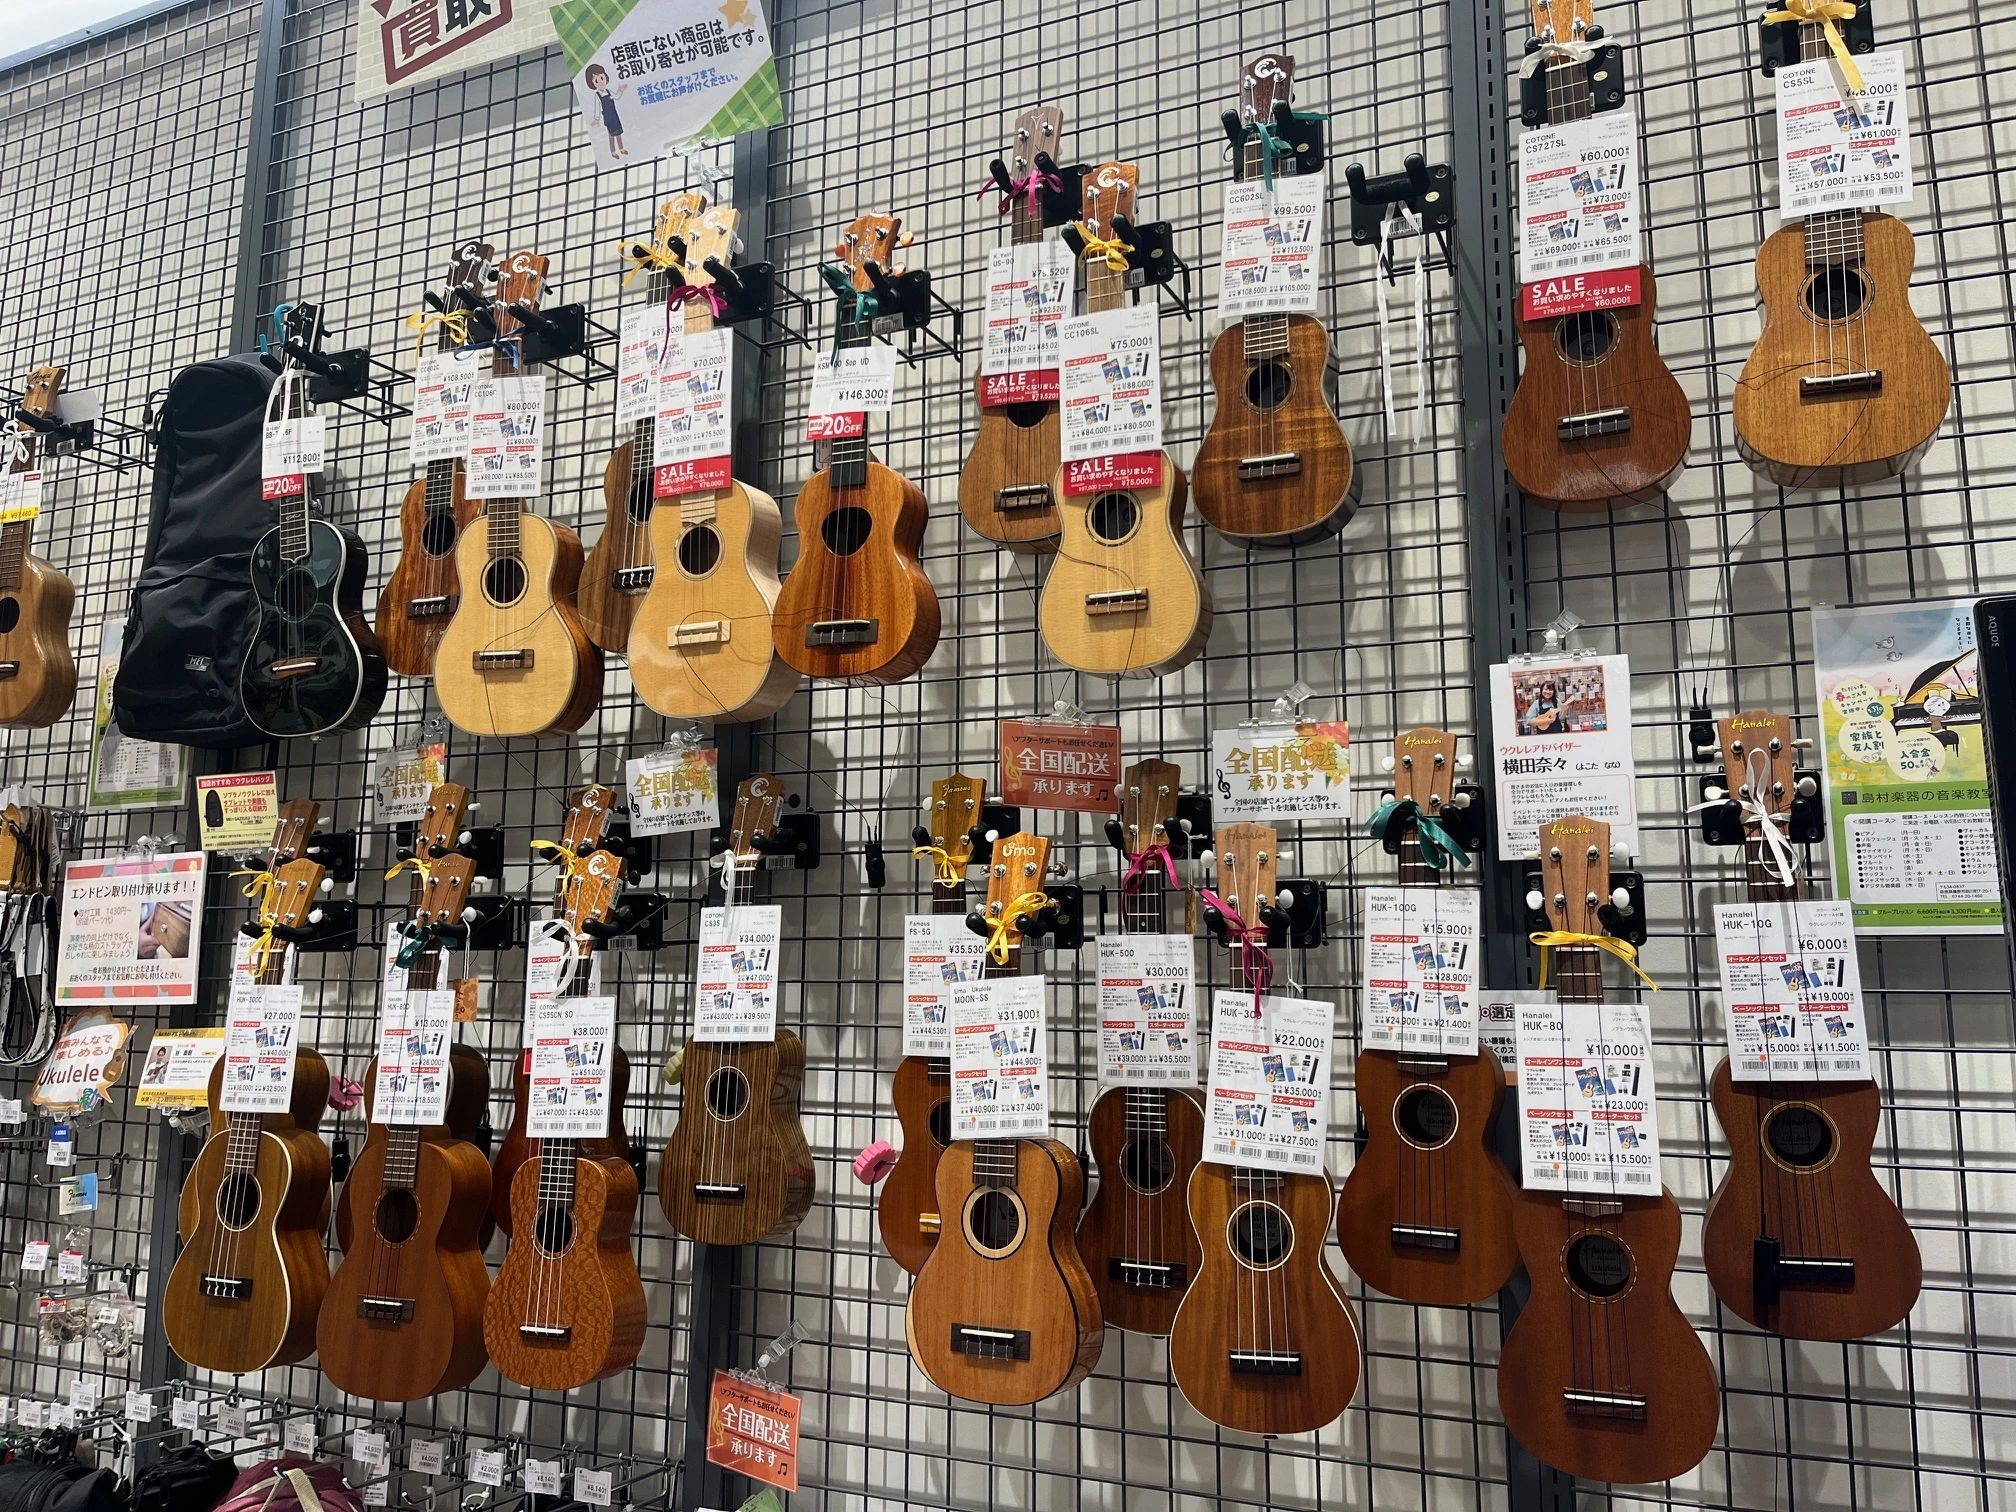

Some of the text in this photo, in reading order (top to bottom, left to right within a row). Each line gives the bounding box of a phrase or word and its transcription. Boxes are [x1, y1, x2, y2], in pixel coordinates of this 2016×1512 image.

[610, 19, 724, 65] 店頭にない商品は
[616, 32, 766, 80] お取り寄せが可能です。
[1783, 68, 1816, 79] COTONE
[1783, 76, 1814, 88] CS5SL
[1526, 133, 1556, 144] COTONE
[1861, 129, 1896, 138] ¥61,000
[1526, 141, 1566, 154] CS727SL
[1580, 148, 1625, 162] ¥60,000
[1864, 172, 1900, 182] ¥53,500
[1808, 178, 1843, 189] ¥57,000
[1229, 187, 1255, 195] COTONE
[1594, 192, 1627, 203] ¥73,000
[1274, 205, 1311, 215] ¥99,500
[1595, 234, 1628, 247] ¥65,500
[1545, 243, 1577, 255] ¥69,000
[1532, 278, 1585, 298] SALE
[1533, 285, 1632, 305] お買い求めやすくなりました
[1064, 322, 1090, 330] COTONE
[1064, 327, 1099, 340] CC106SL
[1111, 337, 1148, 350] ¥75,000
[694, 356, 723, 367] ¥70,000
[988, 374, 1026, 388] SALE
[839, 389, 883, 400] ¥146,300
[507, 402, 536, 410] ¥80,000
[823, 416, 843, 435] 20
[844, 425, 861, 433] OFF
[283, 454, 316, 464] ¥112,800
[660, 463, 694, 479] SALE
[1070, 458, 1114, 475] SALE
[274, 480, 288, 494] 20
[1988, 616, 1999, 647] AQUOS
[1731, 719, 1775, 732] Hanalei
[1850, 731, 1882, 741] 家族と
[1404, 736, 1442, 748] Hanalei
[1852, 742, 1884, 752] 友人割
[1500, 743, 1582, 754] ウクレレアドバイザー
[1901, 749, 1930, 759] 入会金
[1017, 748, 1111, 776] 全国配送
[1224, 742, 1337, 774] 全国配送
[1503, 758, 1567, 775] 横田奈々
[634, 766, 710, 797] 全国配送
[1033, 778, 1094, 796] 承ります
[1248, 772, 1313, 791] 承ります
[392, 785, 426, 800] 承ります
[651, 792, 694, 810] 承ります
[1551, 825, 1594, 839] Hanalei
[71, 880, 196, 899] エンドピン取り付け承ります！！
[1371, 904, 1416, 912] HUK-100G
[1423, 925, 1467, 934] ¥15,900
[1723, 920, 1772, 930] HUK-10G
[949, 945, 984, 954] ¥35,530
[1799, 939, 1842, 950] ¥6,000
[1146, 967, 1184, 976] ¥30,000
[1435, 973, 1468, 982] ¥28,900
[954, 994, 988, 1004] MOON-SS
[1811, 992, 1850, 1001] ¥19,000
[1221, 999, 1248, 1007] Hanalei
[264, 1012, 292, 1020] ¥27,000
[998, 1010, 1035, 1021] ¥31,900
[1435, 1020, 1468, 1028] ¥21,400
[1524, 1022, 1563, 1030] HUK-80
[573, 1027, 604, 1036] ¥38,000
[1275, 1034, 1319, 1048] ¥22,000
[1587, 1045, 1638, 1056] ¥10,000
[1757, 1044, 1796, 1052] ¥15,000
[1817, 1043, 1856, 1052] ¥11,500
[1010, 1057, 1038, 1066] ¥44,900
[1159, 1055, 1187, 1063] ¥35,500
[1285, 1086, 1318, 1098] ¥35,000
[1011, 1103, 1040, 1112] ¥37,400
[1605, 1101, 1643, 1110] ¥23,000
[1230, 1129, 1262, 1140] ¥31,000
[1281, 1135, 1315, 1147] ¥27,500
[1549, 1152, 1587, 1161] ¥19,000
[1609, 1153, 1648, 1164] ¥15,500
[722, 1403, 791, 1449] 全国配送
[731, 1438, 777, 1467] 承ります
